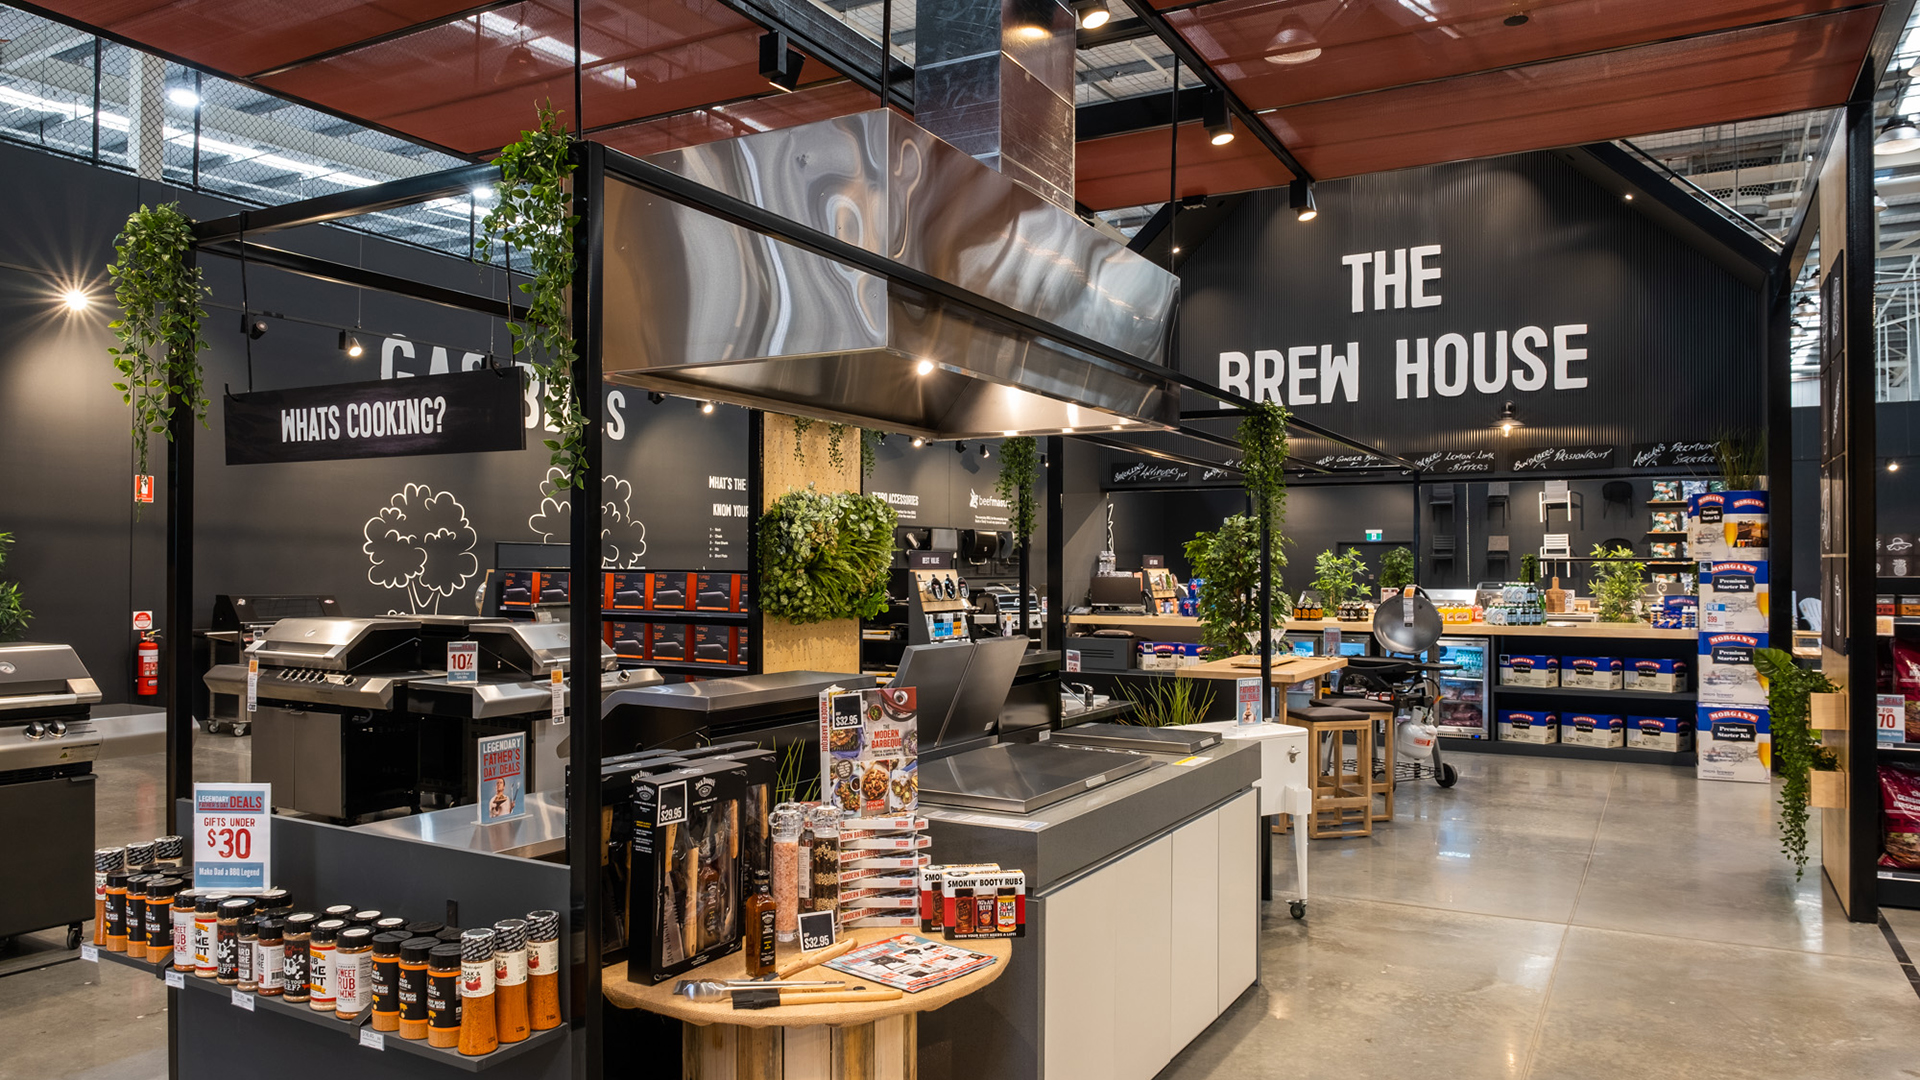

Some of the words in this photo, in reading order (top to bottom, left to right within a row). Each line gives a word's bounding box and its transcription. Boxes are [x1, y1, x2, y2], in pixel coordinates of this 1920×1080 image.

[1342, 244, 1442, 313] THE
[1219, 342, 1359, 410] BREW
[1395, 324, 1588, 400] HOUSE
[281, 406, 341, 443] WHATS
[346, 397, 446, 440] COOKING?
[709, 475, 733, 490] WHAT'S
[734, 478, 747, 491] THE
[1734, 499, 1764, 508] MORGAN'S
[712, 503, 732, 517] KNOW
[1712, 563, 1756, 573] MORGAN'S
[1711, 634, 1756, 645] MORGAN'S
[451, 653, 473, 670] 10%
[820, 701, 828, 723] MODERN
[1711, 711, 1757, 721] MORGAN'S
[835, 715, 858, 727] $32.95
[821, 725, 829, 753] BARBEQUE
[874, 729, 899, 740] MODERN
[483, 737, 521, 754] LEGENDARY
[871, 738, 902, 749] BARBEQUE
[483, 748, 521, 767] FATHER'S
[484, 766, 496, 778] DAY
[500, 761, 520, 775] DEALS
[230, 796, 262, 808] DEALS
[661, 807, 682, 821] $29.95
[204, 817, 226, 827] GIFTS
[230, 818, 255, 827] UNDER
[207, 828, 251, 859] $30
[841, 851, 859, 860] MODERN
[241, 868, 260, 878] Legend
[842, 870, 860, 880] MODERN
[925, 873, 942, 881] SMO
[947, 880, 978, 888] SMOKIN'
[980, 878, 1004, 887] BOOTY
[1005, 877, 1023, 885] RUBS
[841, 891, 859, 900] MODERN
[843, 911, 861, 920] MODERN
[804, 935, 830, 949] $32.95
[338, 978, 356, 989] RUB
